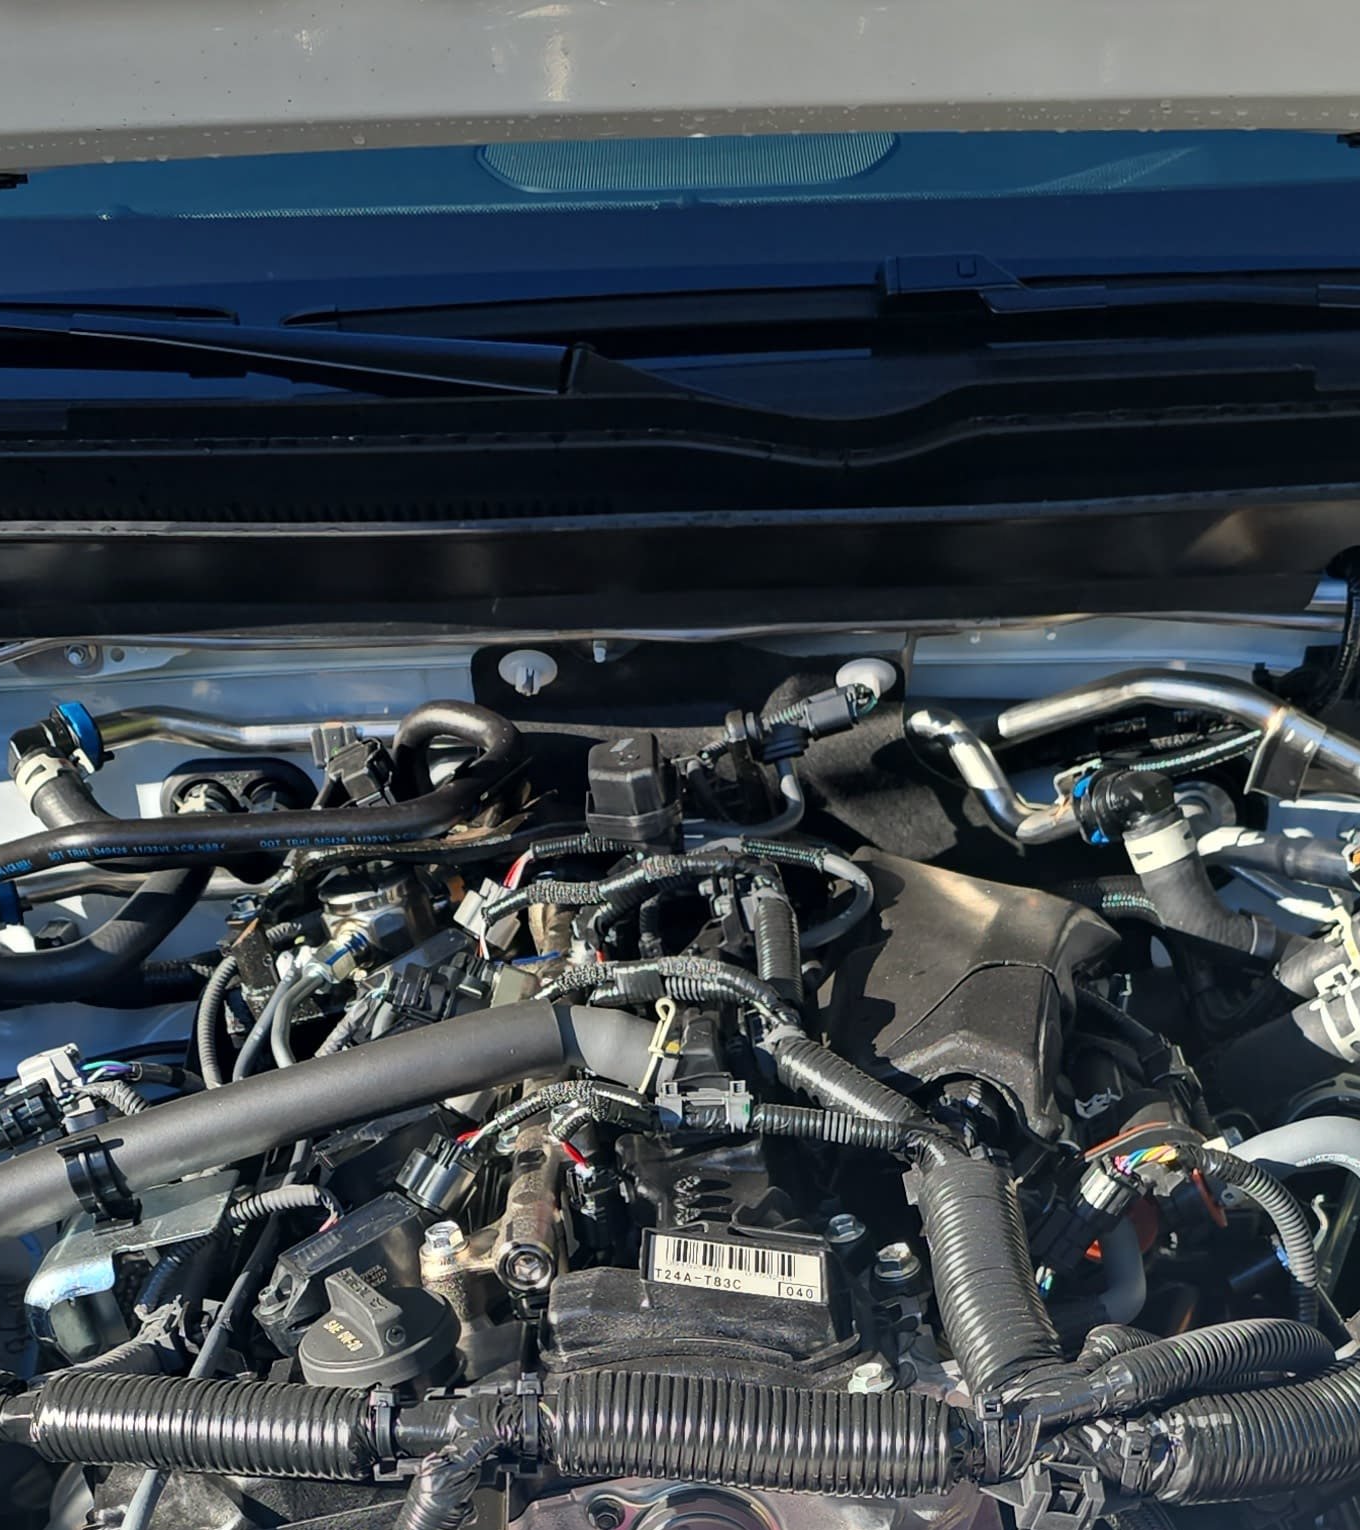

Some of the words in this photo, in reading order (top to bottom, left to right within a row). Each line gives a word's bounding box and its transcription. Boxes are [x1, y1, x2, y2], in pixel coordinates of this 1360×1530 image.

[655, 1268, 742, 1290] T24A-T83C
[786, 1286, 814, 1299] 040
[323, 1320, 344, 1334] SAE
